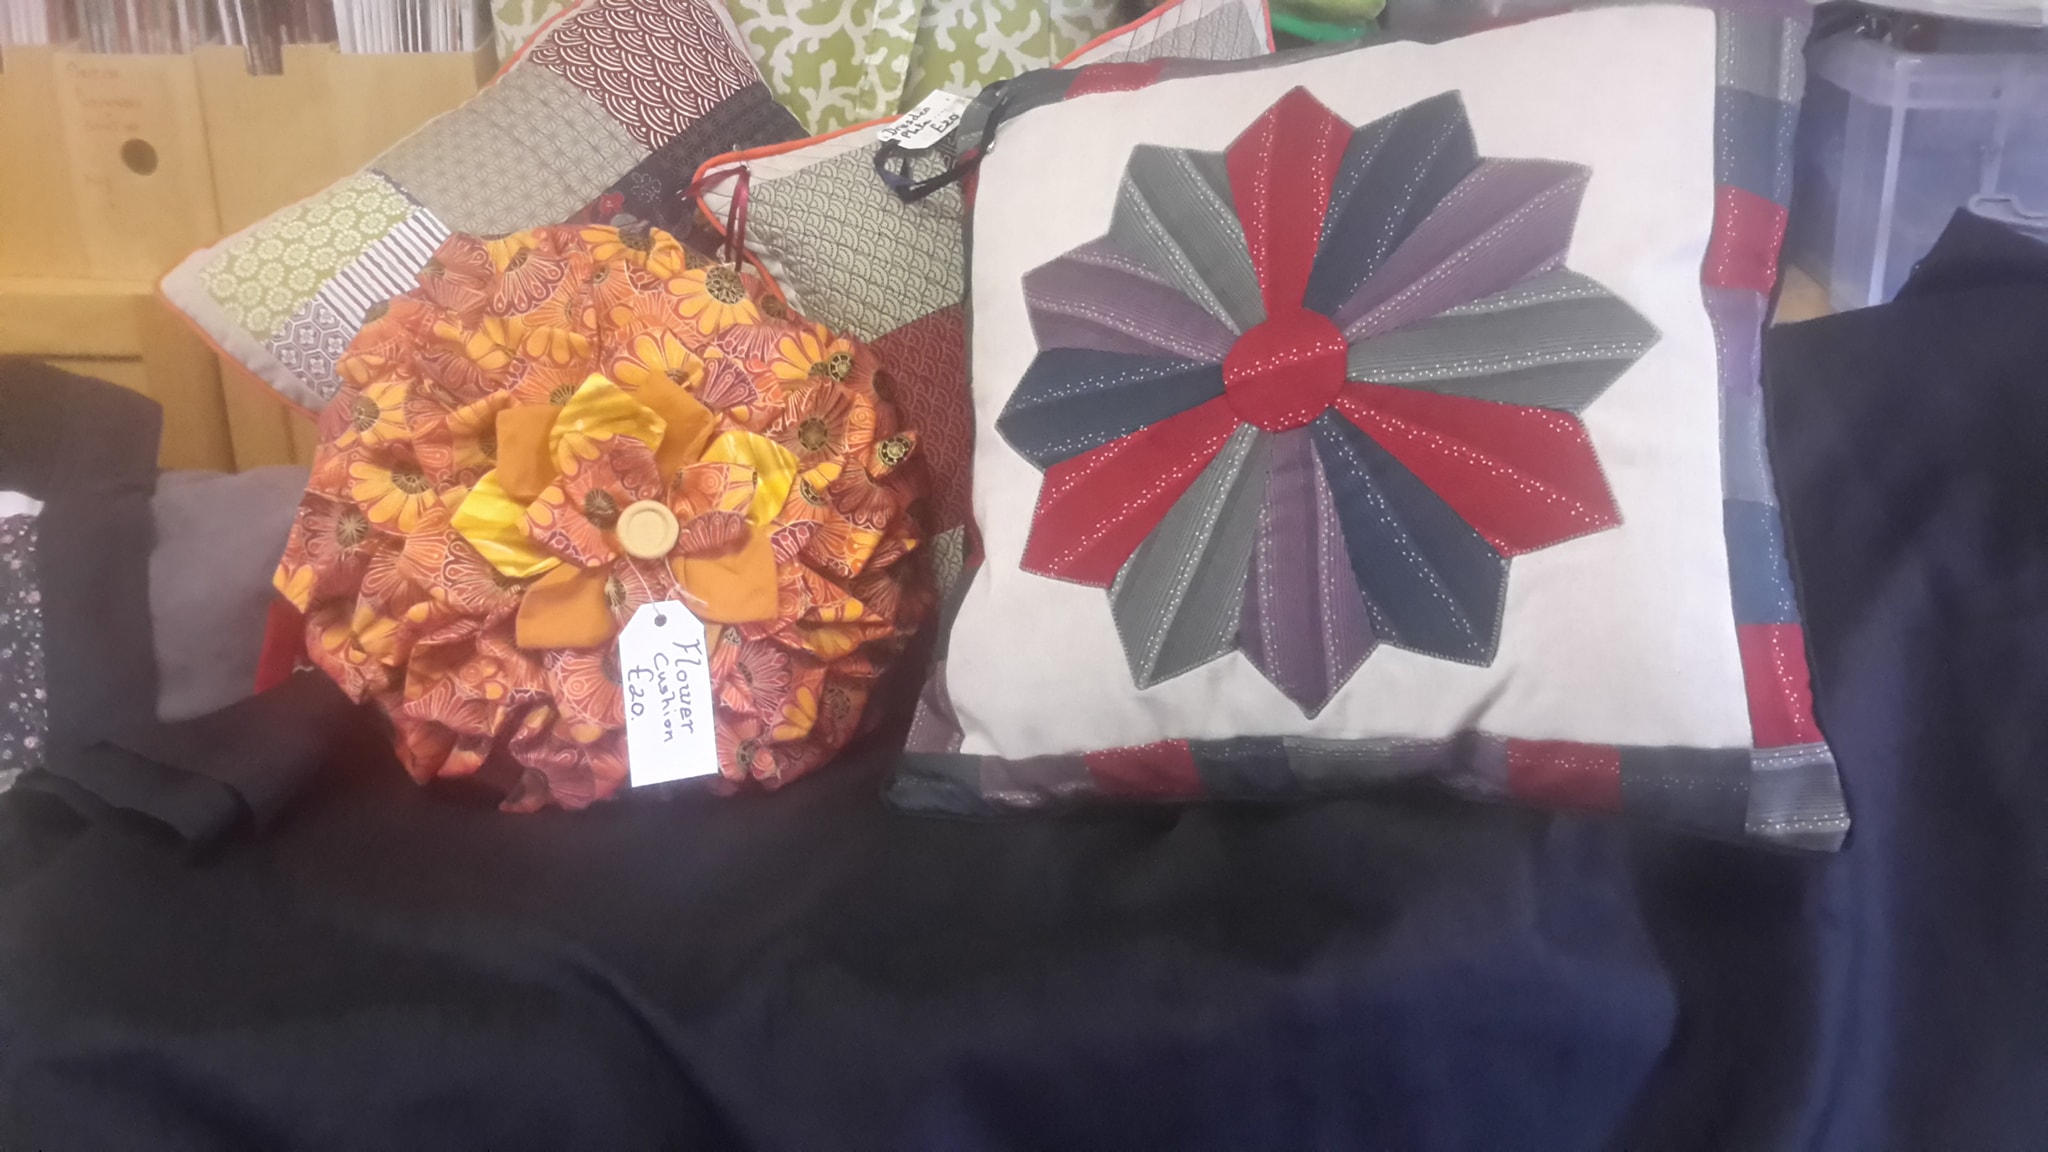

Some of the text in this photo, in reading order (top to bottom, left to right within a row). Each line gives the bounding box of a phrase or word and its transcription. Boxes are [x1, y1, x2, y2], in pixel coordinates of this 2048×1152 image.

[881, 107, 931, 136] Dresden
[653, 652, 676, 743] Cushion
[672, 638, 703, 734] Flower
